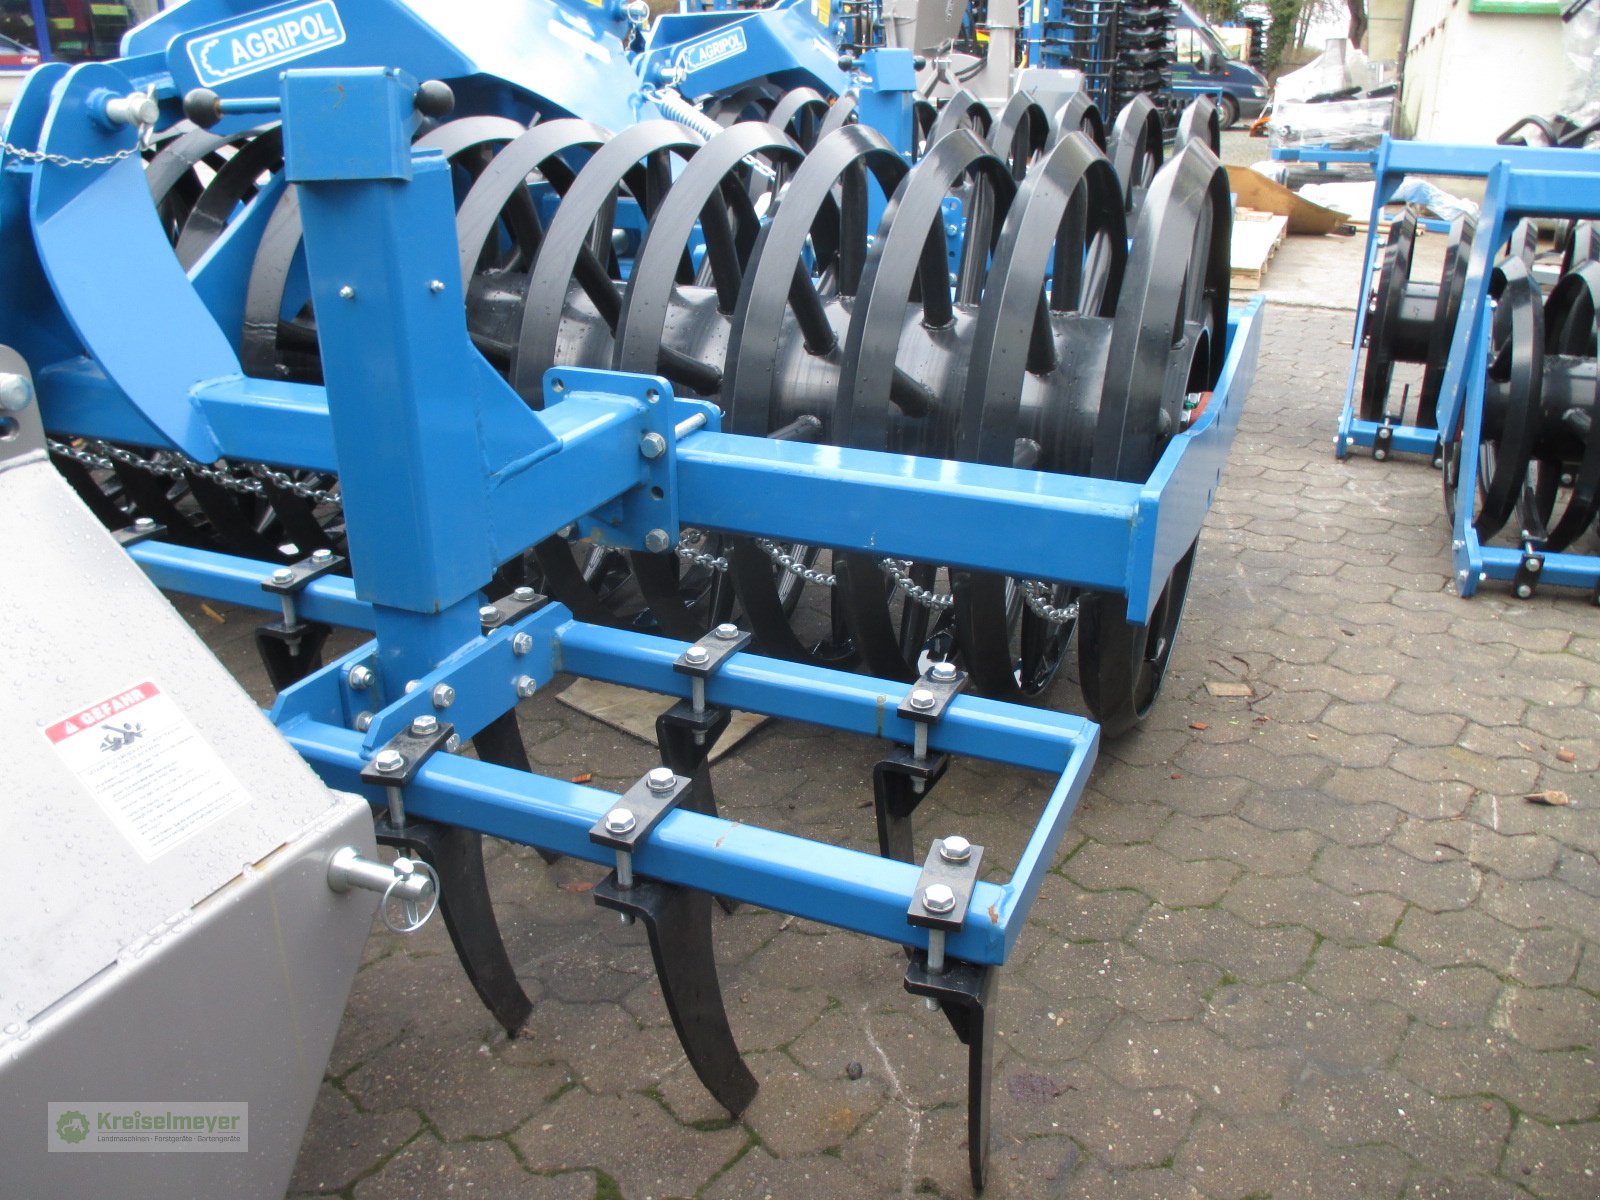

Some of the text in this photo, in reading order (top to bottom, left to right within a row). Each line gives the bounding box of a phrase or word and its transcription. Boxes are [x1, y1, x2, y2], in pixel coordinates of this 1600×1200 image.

[231, 13, 335, 65] AGRIPOL
[699, 33, 743, 61] AGRIPOL
[80, 690, 145, 723] GEFAHR
